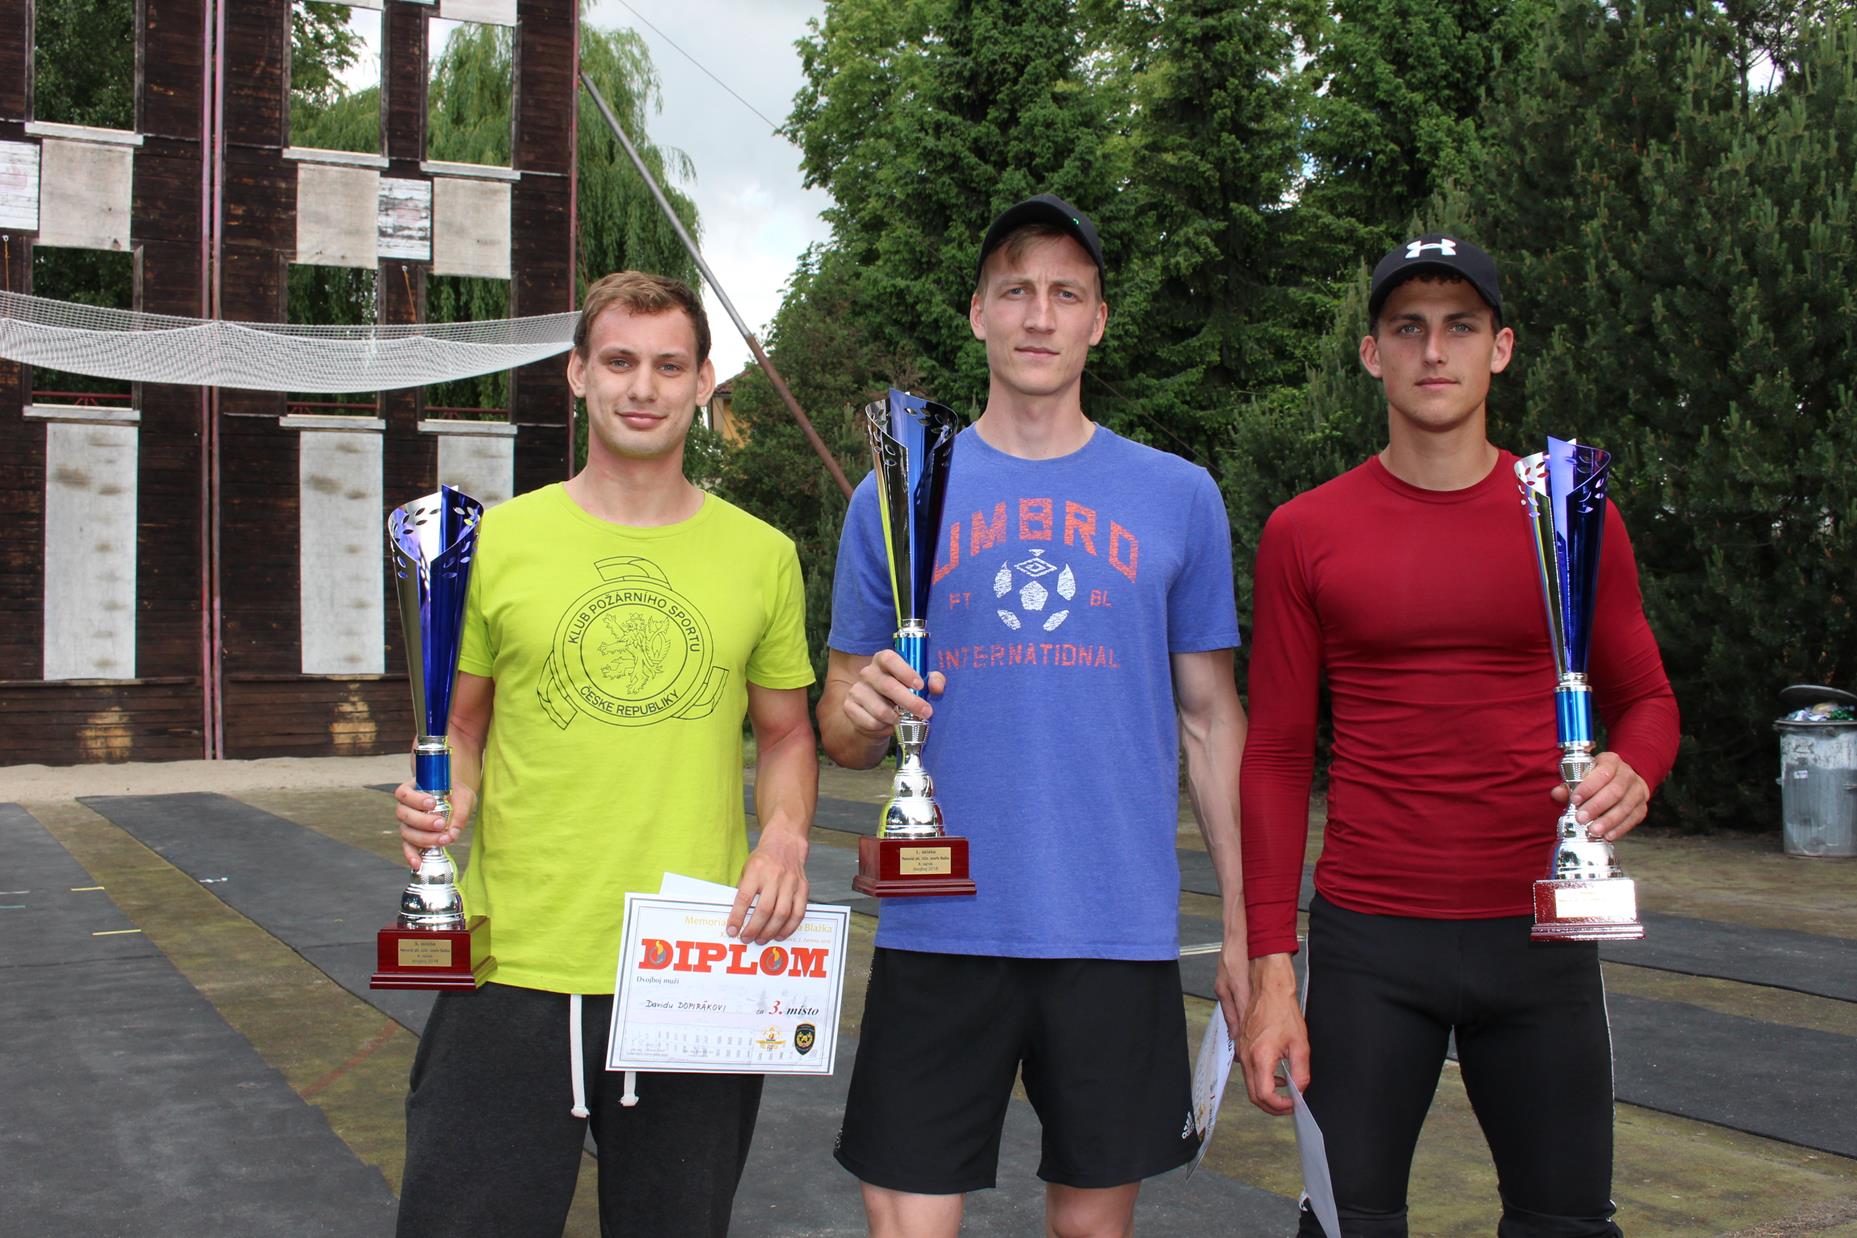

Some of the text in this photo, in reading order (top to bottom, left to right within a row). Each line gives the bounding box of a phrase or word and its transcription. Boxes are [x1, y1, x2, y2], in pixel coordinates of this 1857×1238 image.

[1090, 589, 1112, 608] BL
[568, 591, 701, 652] KLUB POŽÁRNÍHO SPORTU
[937, 642, 1120, 669] INTERNATIONAL
[616, 689, 679, 716] REPUBLIKY
[638, 938, 829, 979] DIPLOM
[768, 1000, 783, 1015] 3.
[786, 1004, 820, 1016] místo
